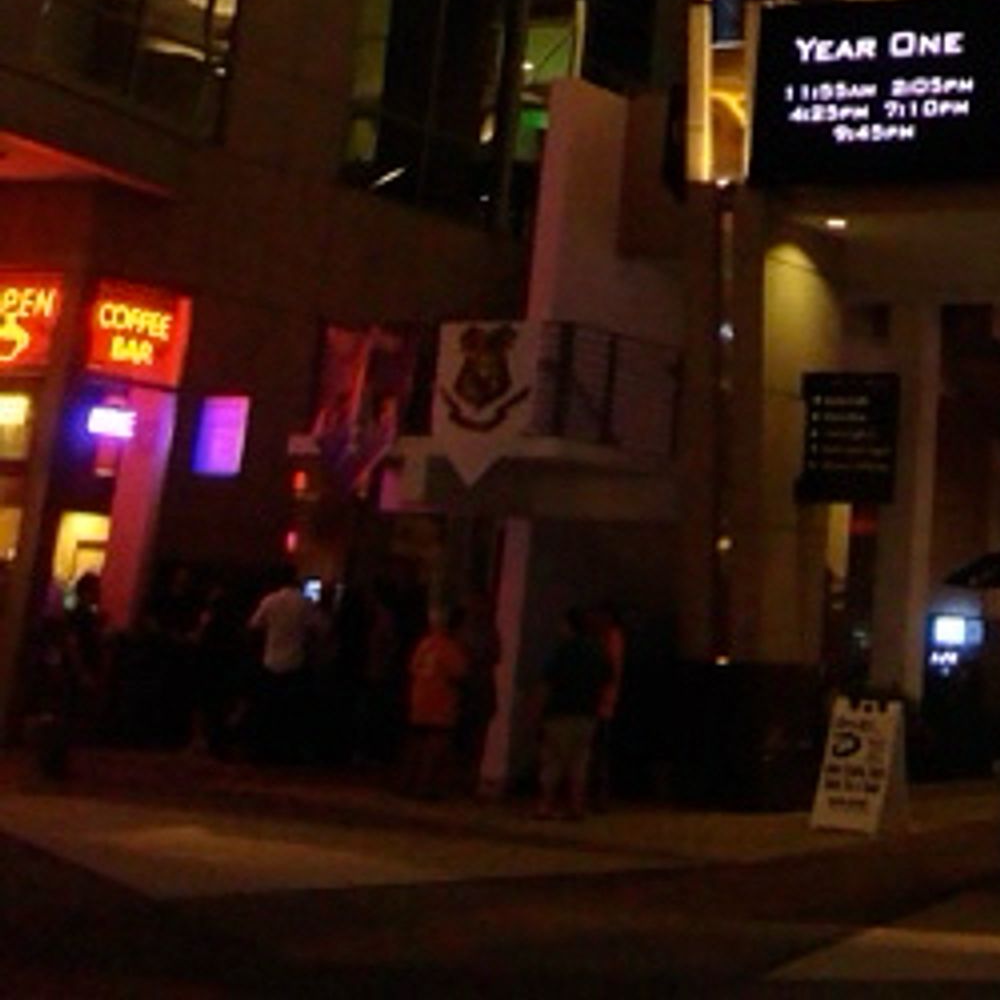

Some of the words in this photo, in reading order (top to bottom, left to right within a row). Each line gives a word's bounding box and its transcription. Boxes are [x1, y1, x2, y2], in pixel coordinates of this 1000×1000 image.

[795, 36, 878, 62] YEAR
[889, 31, 965, 57] ONE
[884, 99, 970, 118] 7:10PM
[0, 287, 56, 319] PEN
[99, 302, 173, 341] COFFEE
[111, 336, 154, 365] BAR
